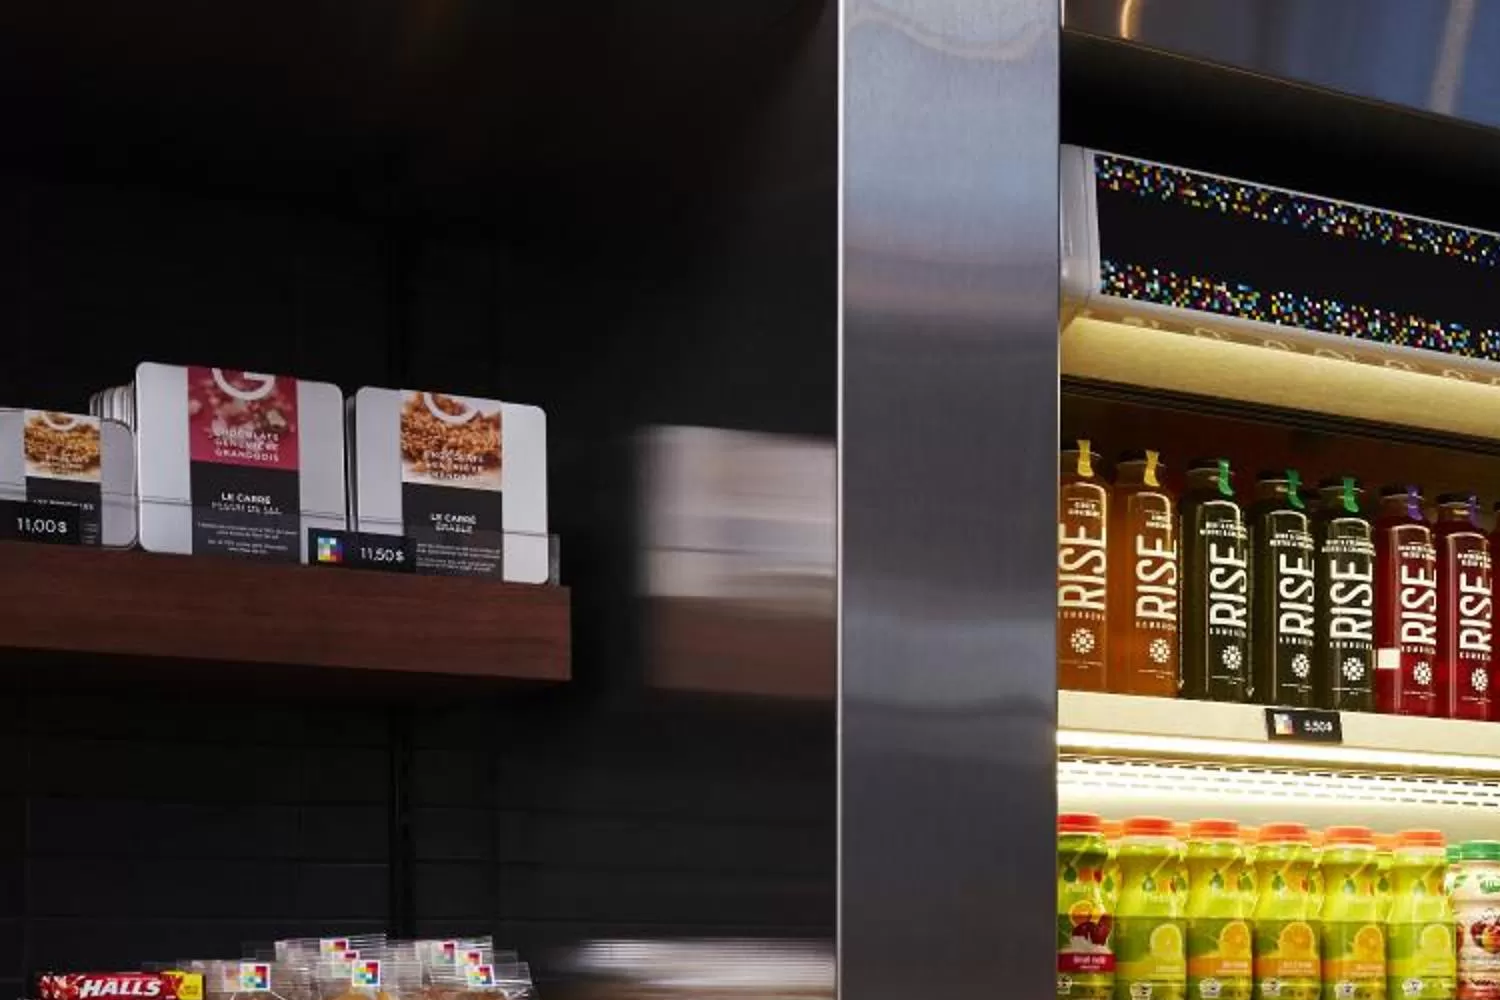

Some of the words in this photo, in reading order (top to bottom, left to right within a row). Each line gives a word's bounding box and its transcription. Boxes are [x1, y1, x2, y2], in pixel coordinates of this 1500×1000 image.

[1058, 522, 1107, 610] RISE
[1136, 534, 1177, 621] RISE
[1209, 543, 1247, 629] RISE
[1279, 553, 1315, 637] RISE
[1329, 559, 1373, 641] RISE
[1401, 565, 1436, 646] RISE
[1459, 572, 1492, 652] RISE
[79, 979, 162, 999] HALLS
